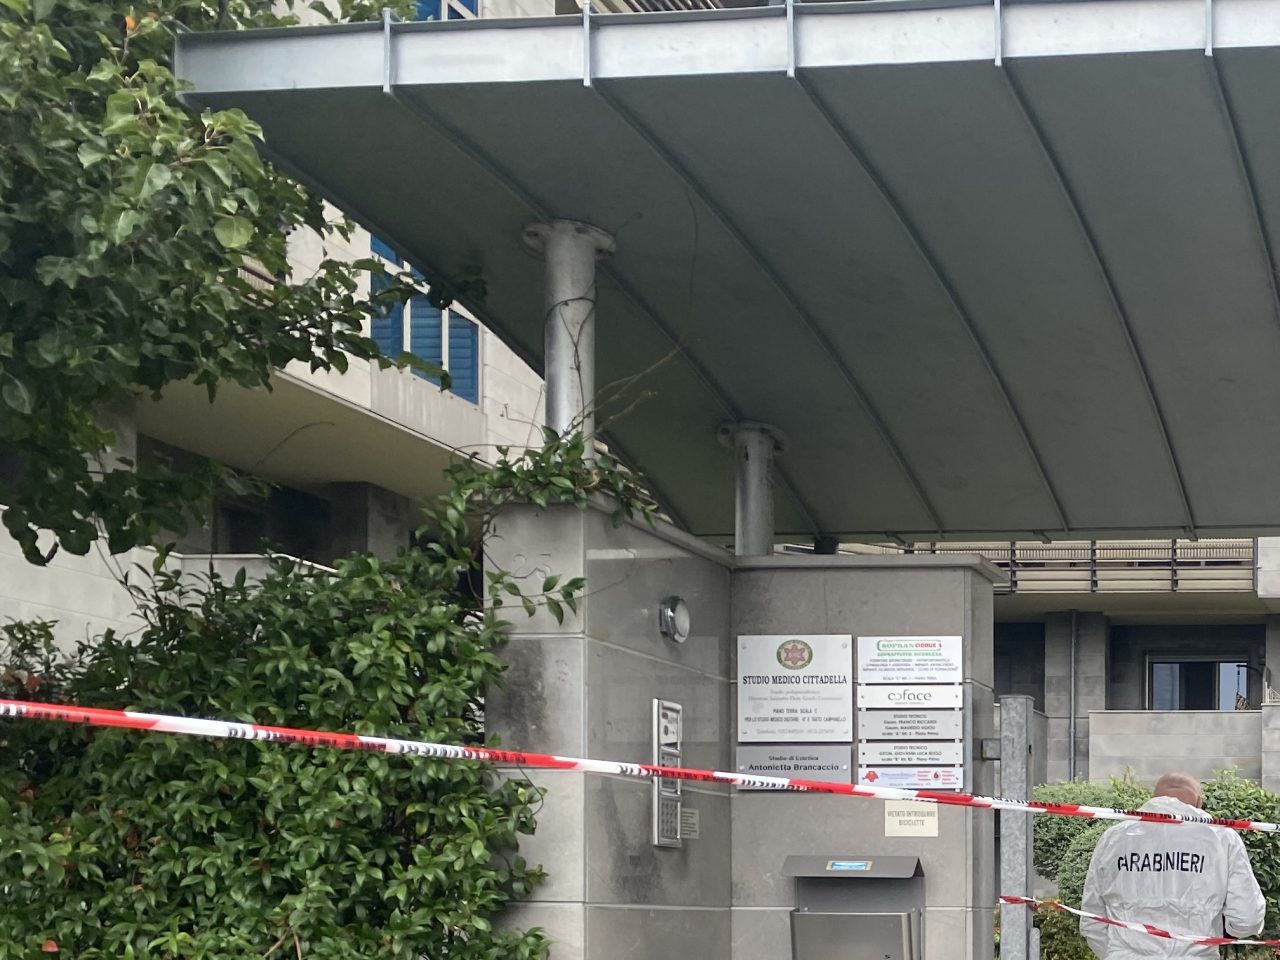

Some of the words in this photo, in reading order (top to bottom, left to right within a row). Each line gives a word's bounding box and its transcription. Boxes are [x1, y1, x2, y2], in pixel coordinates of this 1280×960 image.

[742, 675, 770, 685] STUDIO
[771, 675, 801, 685] MEDICO
[802, 675, 848, 685] CITTADELLA
[887, 689, 933, 701] coface
[748, 763, 792, 771] Antonietta
[793, 763, 839, 771] Brancaccio
